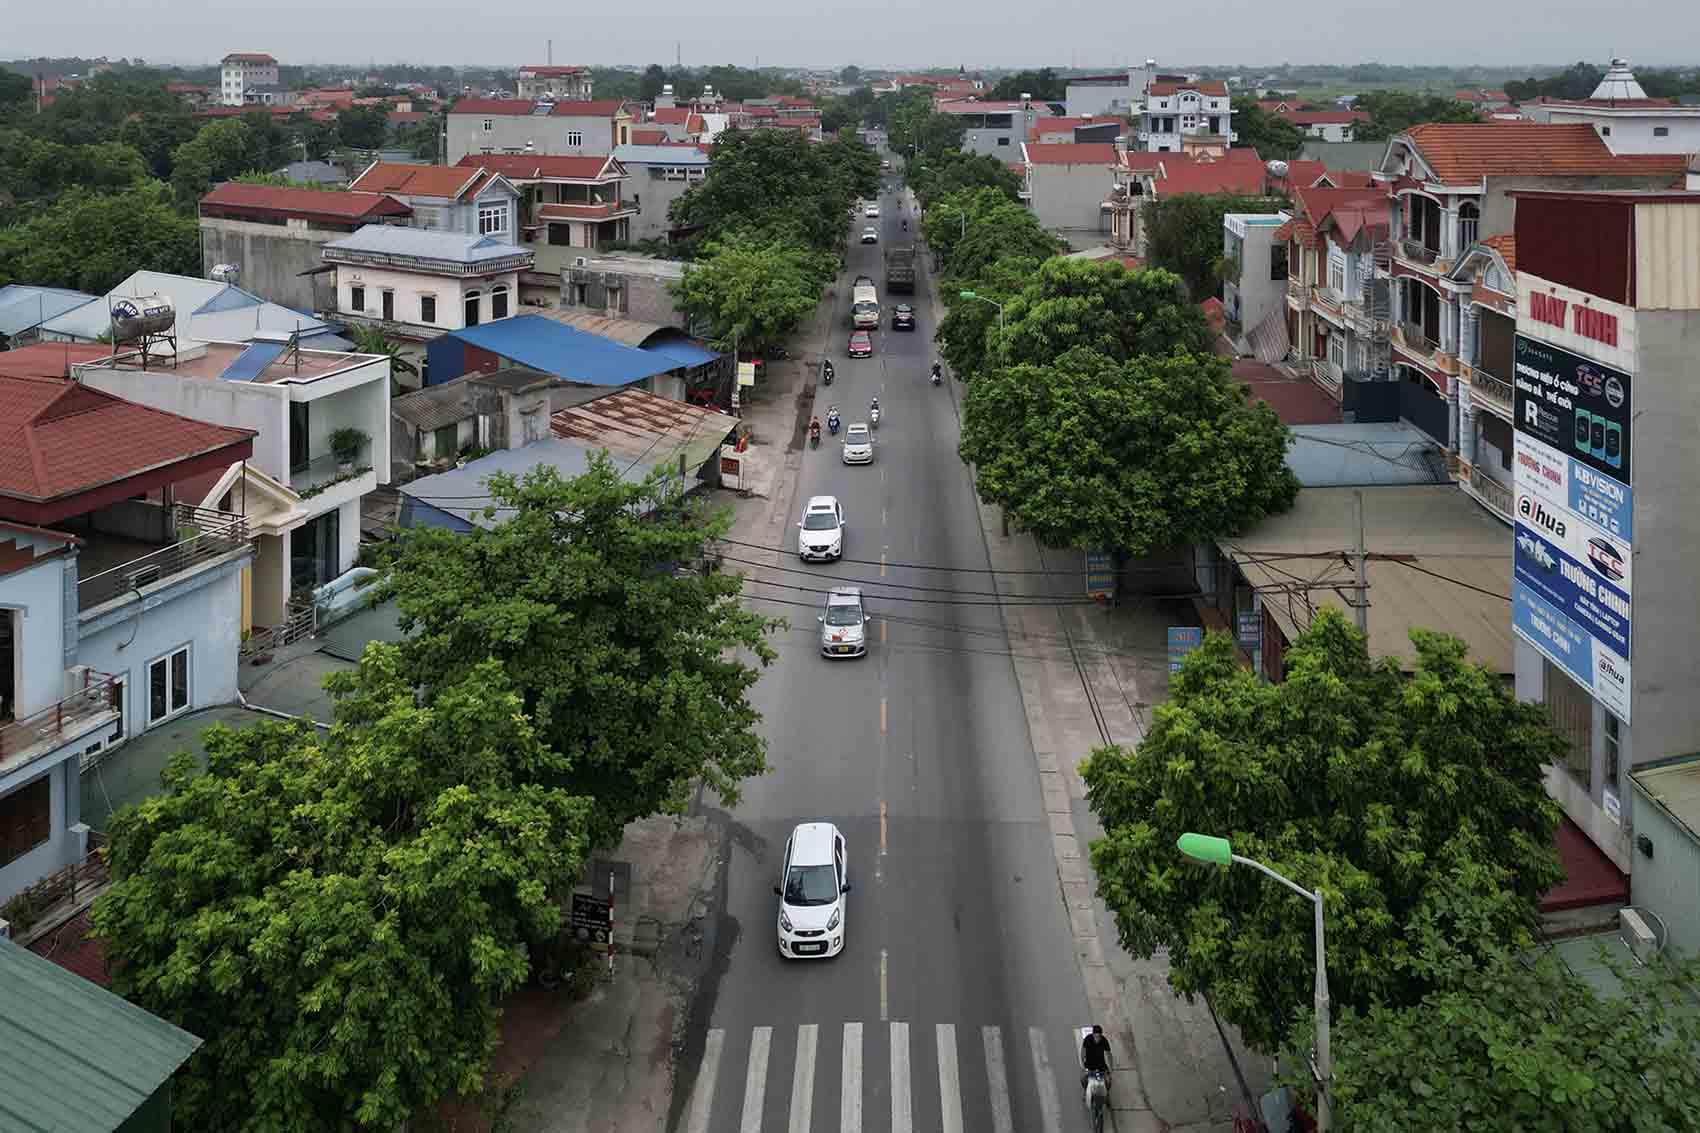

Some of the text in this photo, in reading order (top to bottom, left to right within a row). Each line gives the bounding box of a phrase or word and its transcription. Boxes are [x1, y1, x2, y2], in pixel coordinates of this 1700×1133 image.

[1530, 287, 1617, 347] MÁY TÍNH
[1525, 399, 1538, 427] R
[1575, 464, 1624, 504] KBVISION
[1588, 543, 1624, 575] TCC
